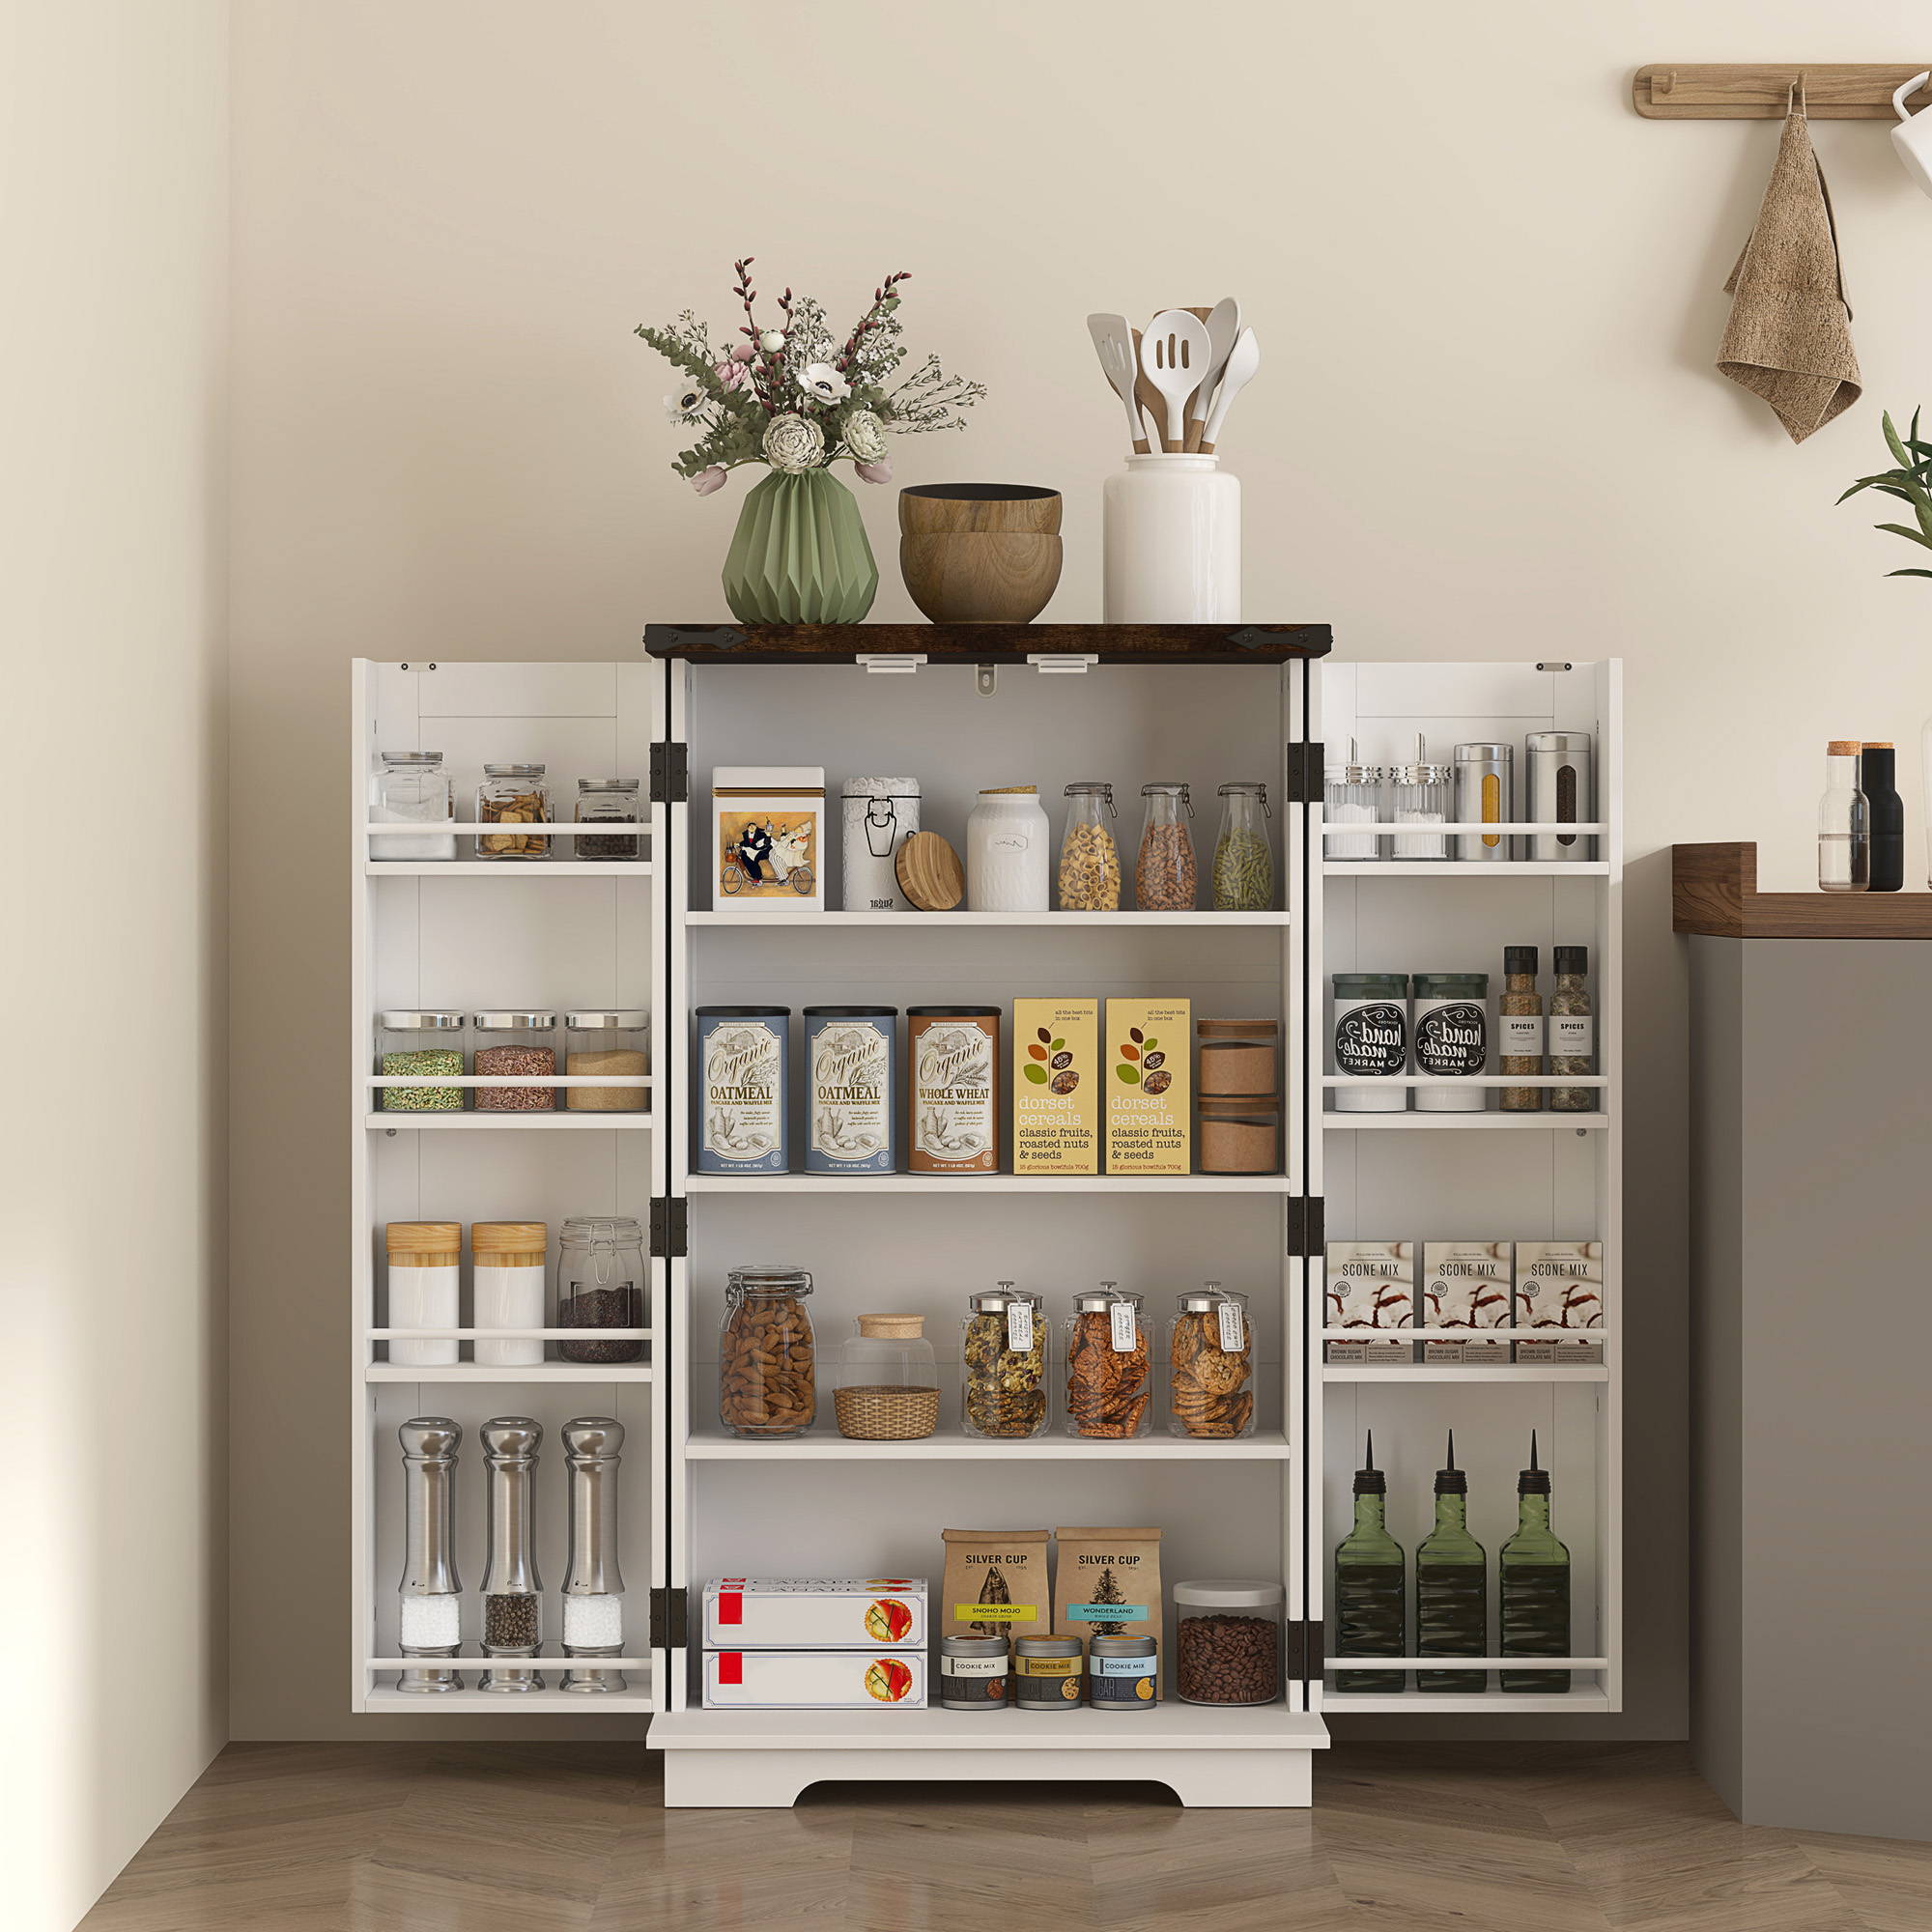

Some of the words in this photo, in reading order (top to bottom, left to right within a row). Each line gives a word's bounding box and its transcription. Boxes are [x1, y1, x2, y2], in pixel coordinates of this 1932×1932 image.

[708, 1038, 772, 1085] Organic
[816, 1038, 879, 1085] Organic
[920, 1038, 983, 1085] Organic
[711, 1086, 773, 1099] OATMEAL
[818, 1086, 880, 1099] OATMEAL
[919, 1089, 953, 1098] WHOLE
[956, 1089, 989, 1098] WHEAT
[1019, 1095, 1074, 1109] dorset
[1112, 1095, 1167, 1109] dorset
[1019, 1112, 1081, 1125] cereals
[1112, 1112, 1174, 1125] cereals
[1019, 1128, 1056, 1137] classic
[1060, 1128, 1093, 1138] fruits,
[1112, 1128, 1149, 1137] classic
[1151, 1128, 1185, 1138] fruits,
[1019, 1139, 1061, 1148] roasted
[1112, 1139, 1153, 1148] roasted
[1019, 1150, 1029, 1159] &
[1032, 1151, 1062, 1159] seeds
[1112, 1150, 1122, 1159] &
[1123, 1151, 1154, 1159] seeds
[1343, 1264, 1376, 1276] SCONE
[1380, 1264, 1399, 1276] MIX
[1439, 1264, 1472, 1276] SCONE
[1478, 1264, 1495, 1276] MIX
[1531, 1264, 1565, 1276] SCONE
[1569, 1264, 1588, 1276] MIX
[966, 1554, 1002, 1564] SILVER
[1006, 1554, 1028, 1564] CUP
[1079, 1555, 1115, 1564] SILVER
[1119, 1555, 1140, 1565] CUP
